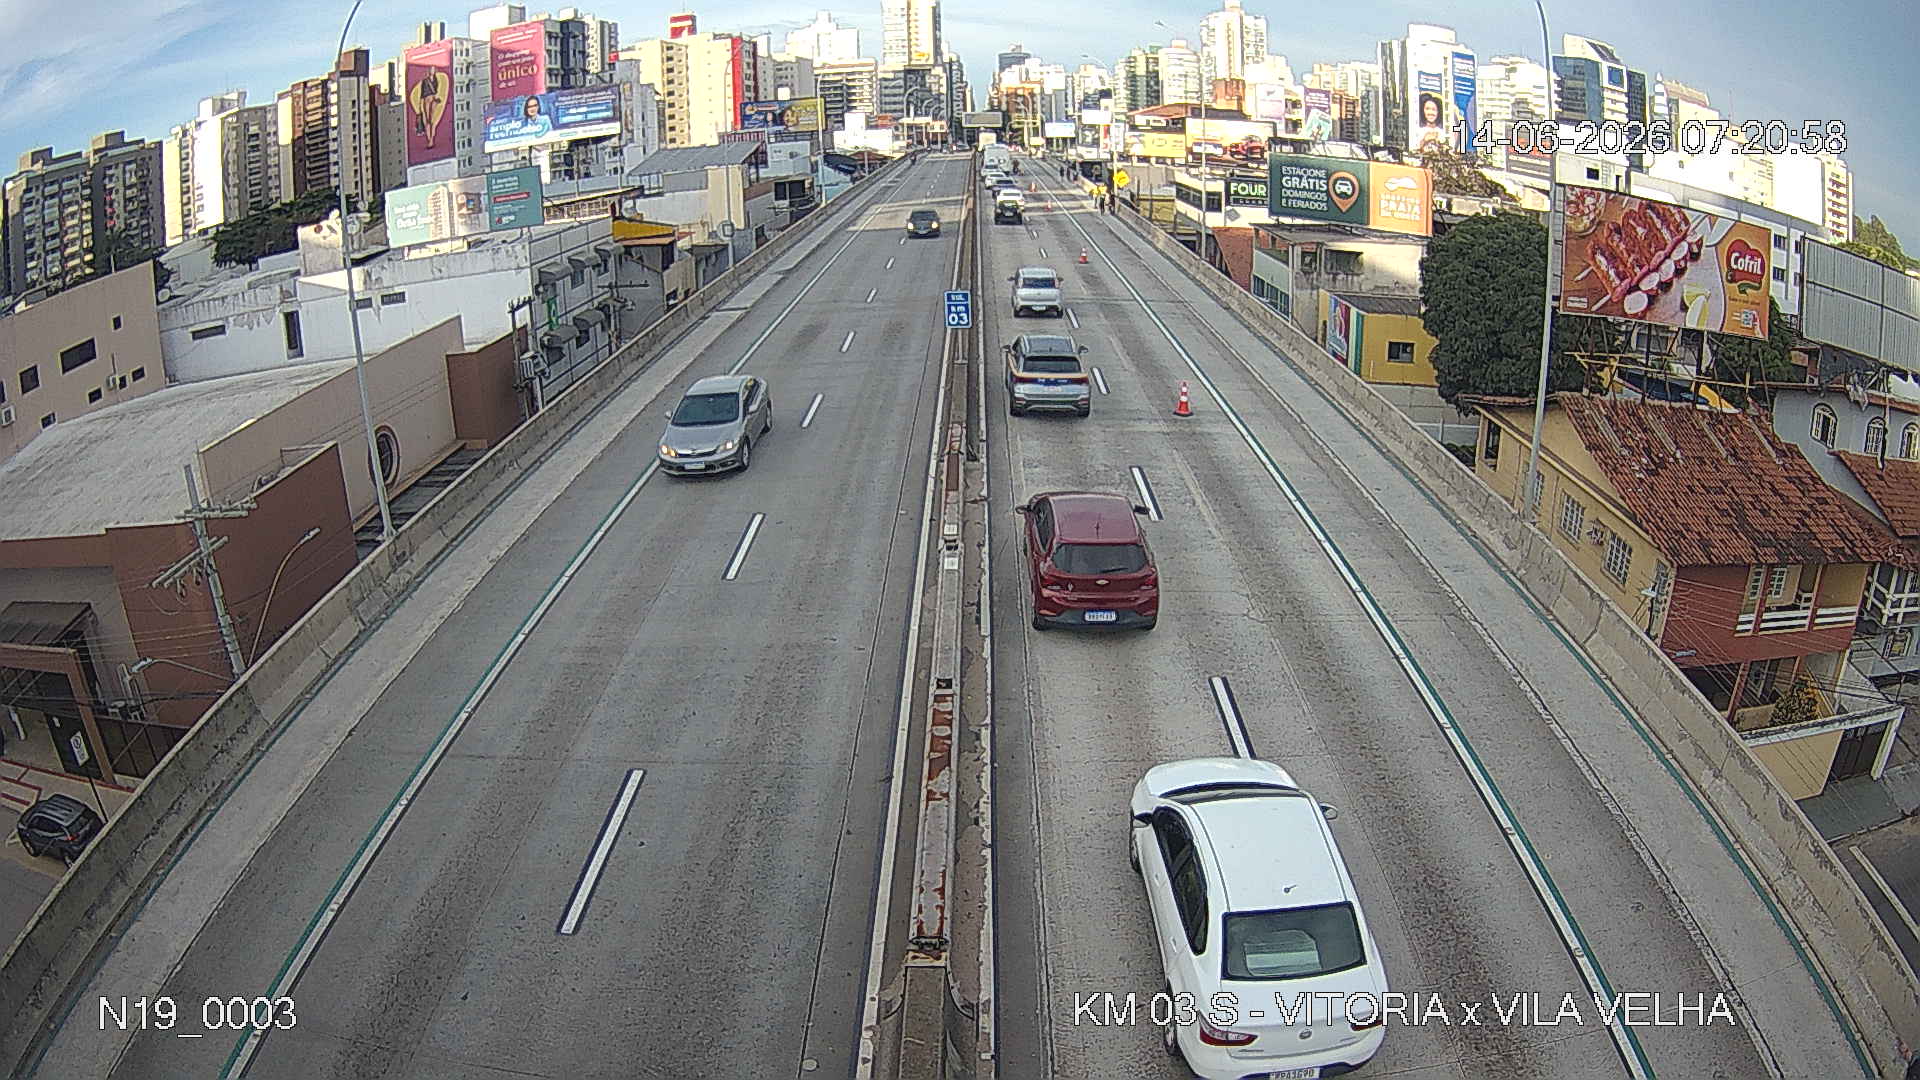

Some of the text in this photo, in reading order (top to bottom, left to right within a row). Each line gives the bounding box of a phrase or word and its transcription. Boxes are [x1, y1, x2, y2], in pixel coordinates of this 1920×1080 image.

[497, 63, 538, 81] único
[1281, 166, 1327, 178] ESTACIONE
[1230, 182, 1267, 197] FOUR
[1281, 175, 1328, 191] GRÁTIS
[1281, 188, 1328, 202] DOMINGOS
[1281, 198, 1328, 211] E FERIADOS
[1730, 252, 1762, 275] Cofril
[949, 313, 969, 325] 03
